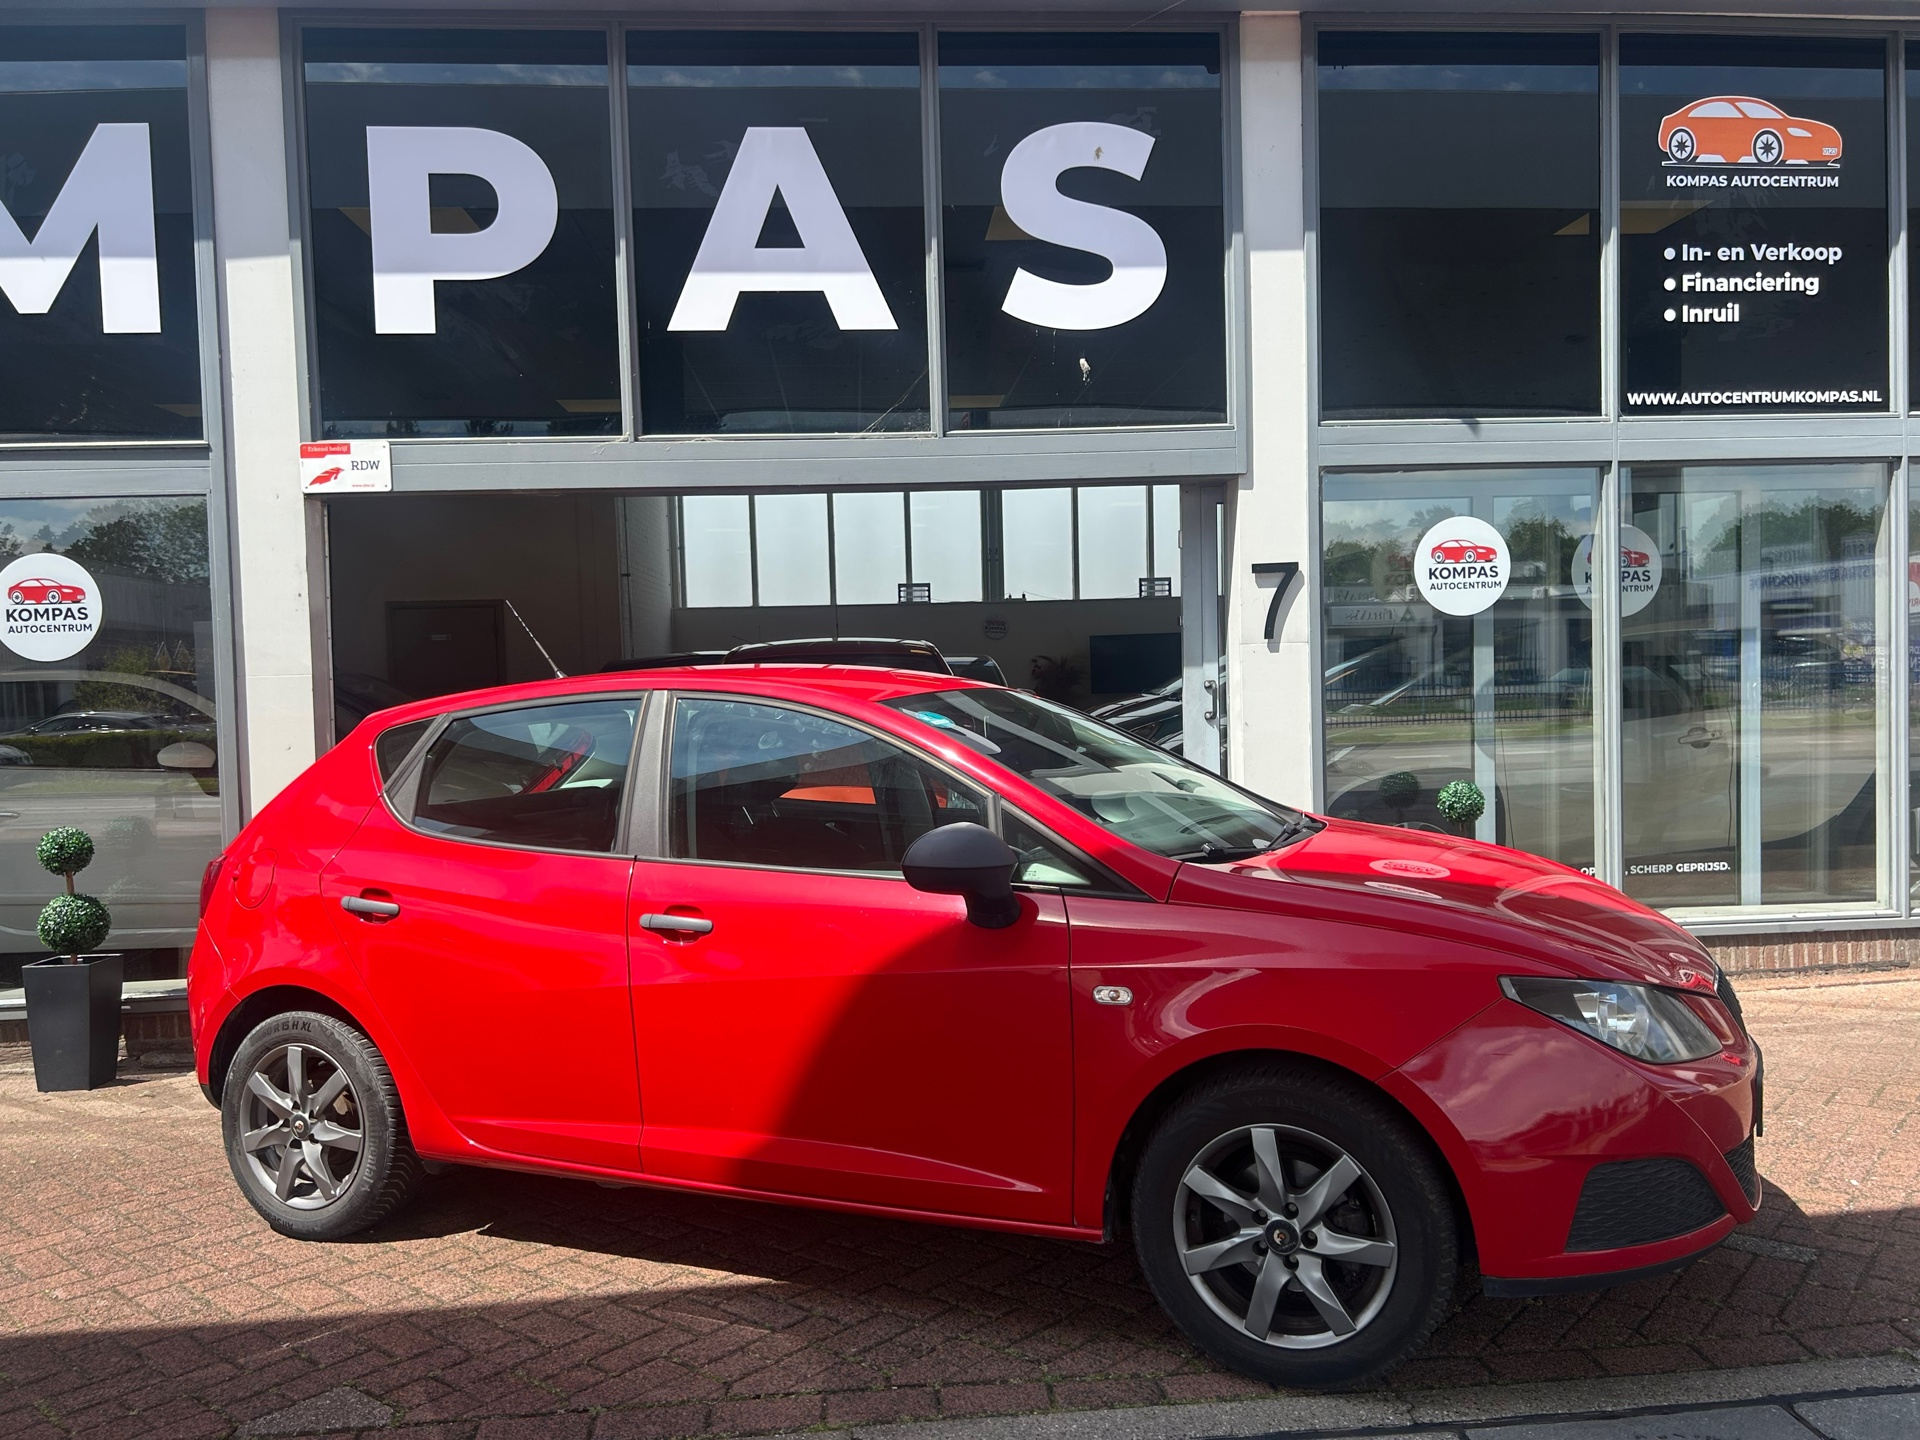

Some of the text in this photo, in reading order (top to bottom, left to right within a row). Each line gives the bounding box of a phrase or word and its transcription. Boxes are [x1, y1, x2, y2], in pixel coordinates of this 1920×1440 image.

[1666, 175, 1839, 188] KOMPAS AUTOCENTRUM
[1681, 243, 1843, 265] In- en Verkoop
[1681, 272, 1820, 295] Financiering
[1681, 303, 1740, 323] Inruil
[1627, 390, 1883, 405] WWW.AUTOCENTRUMKOMPAS.NL
[350, 460, 380, 471] RDW
[1428, 565, 1499, 580] KOMPAS
[1584, 570, 1651, 583] KPAS
[1429, 581, 1502, 590] AUTOCENTRUM
[1585, 584, 1654, 593] ANTRUM
[1252, 562, 1299, 639] 7
[6, 607, 89, 622] KOMPAS
[8, 623, 93, 634] AUTOCENTRUM
[1629, 864, 1673, 874] SCHERP
[1675, 862, 1731, 873] GEPRIJSD.
